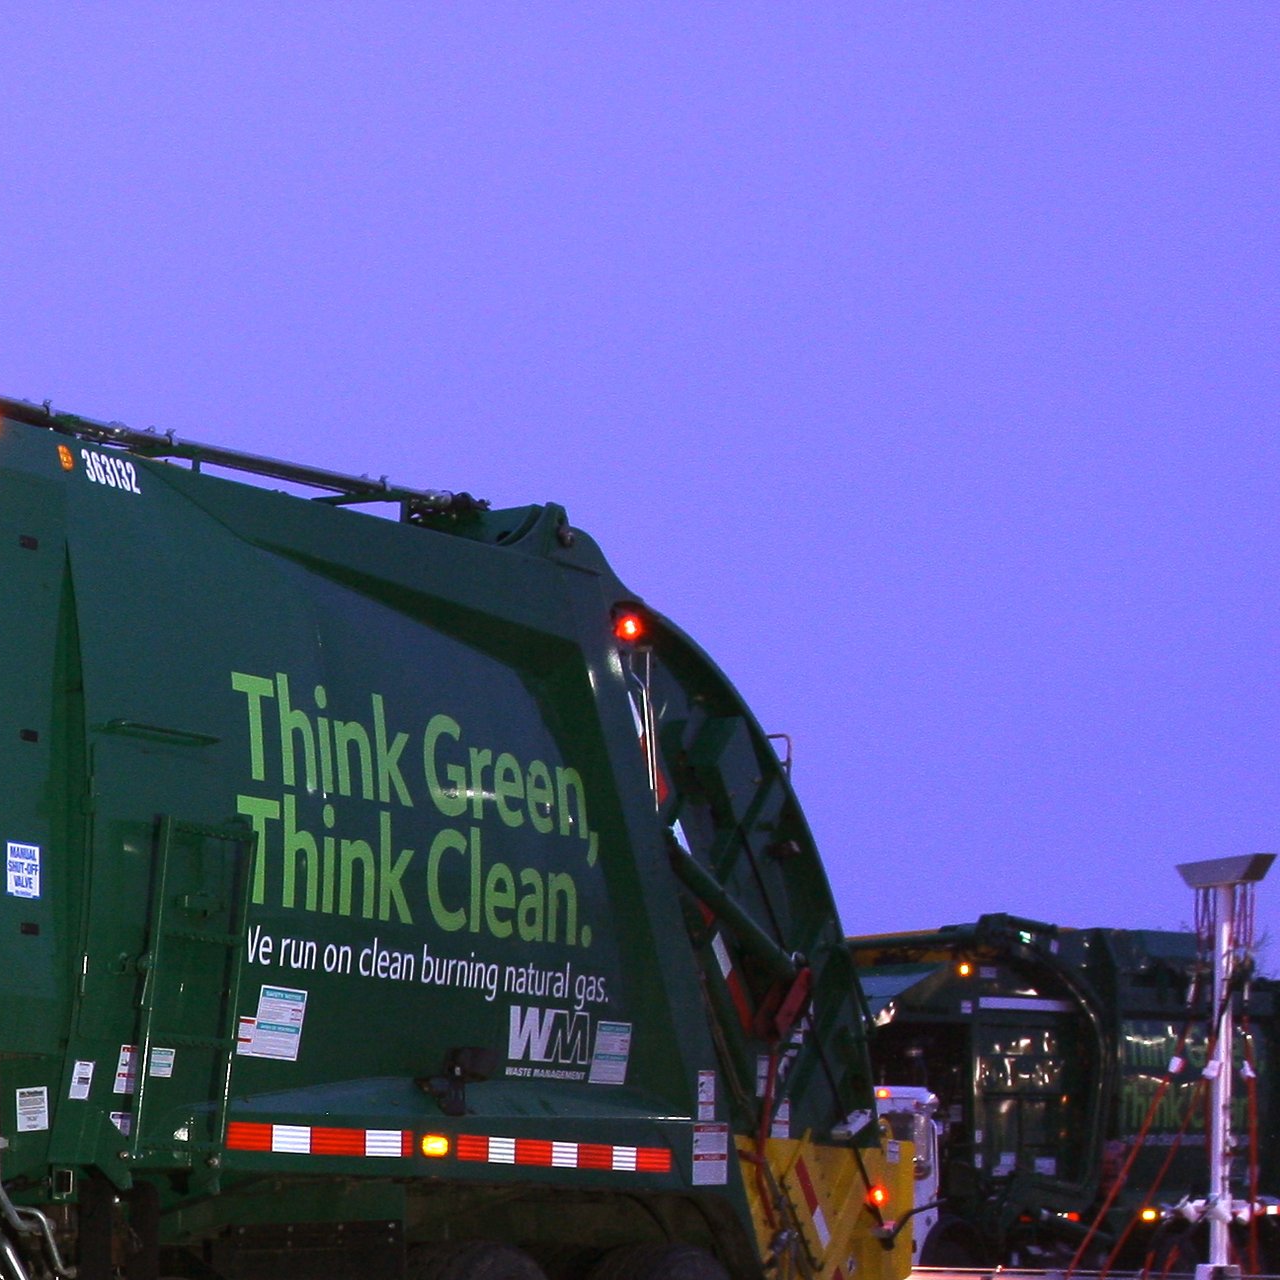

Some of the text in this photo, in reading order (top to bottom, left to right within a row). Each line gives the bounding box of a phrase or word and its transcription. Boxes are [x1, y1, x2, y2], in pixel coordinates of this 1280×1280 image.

[81, 448, 141, 495] 363132
[231, 671, 600, 868] Think Green,
[237, 793, 593, 949] Think Clean.
[279, 938, 317, 970] run
[323, 943, 352, 974] on
[359, 937, 415, 981] clean
[420, 944, 499, 1001] burning
[504, 962, 571, 999] natural
[574, 974, 609, 1010] gas.
[507, 1005, 590, 1065] WM
[505, 1066, 586, 1080] WASTE MANAGEMENT
